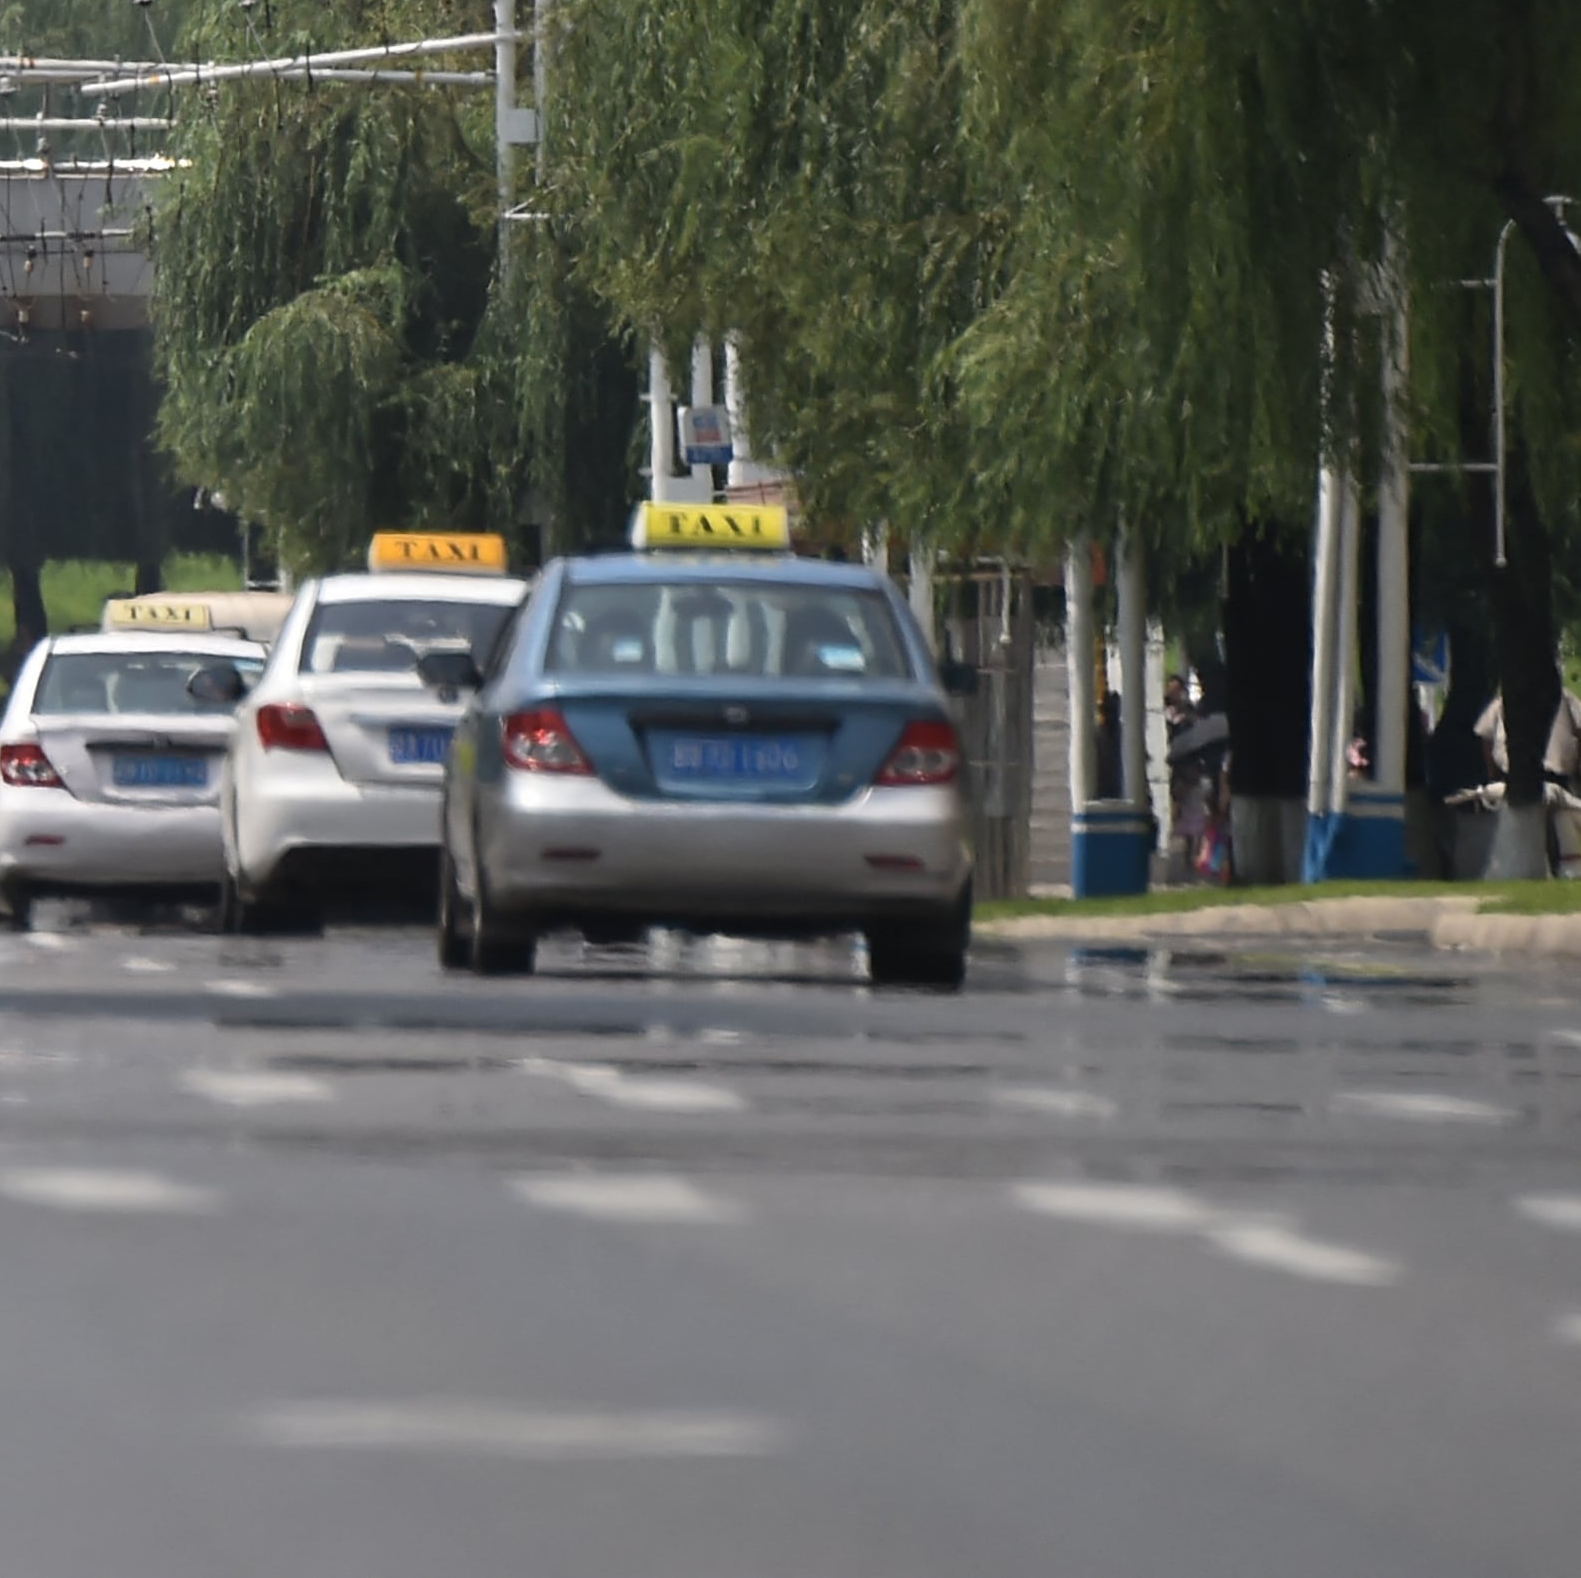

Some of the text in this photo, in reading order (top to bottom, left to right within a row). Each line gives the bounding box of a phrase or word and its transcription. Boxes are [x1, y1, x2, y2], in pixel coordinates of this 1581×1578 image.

[662, 512, 762, 536] TAXI
[394, 540, 481, 561] TAXI
[123, 604, 192, 622] TAXI
